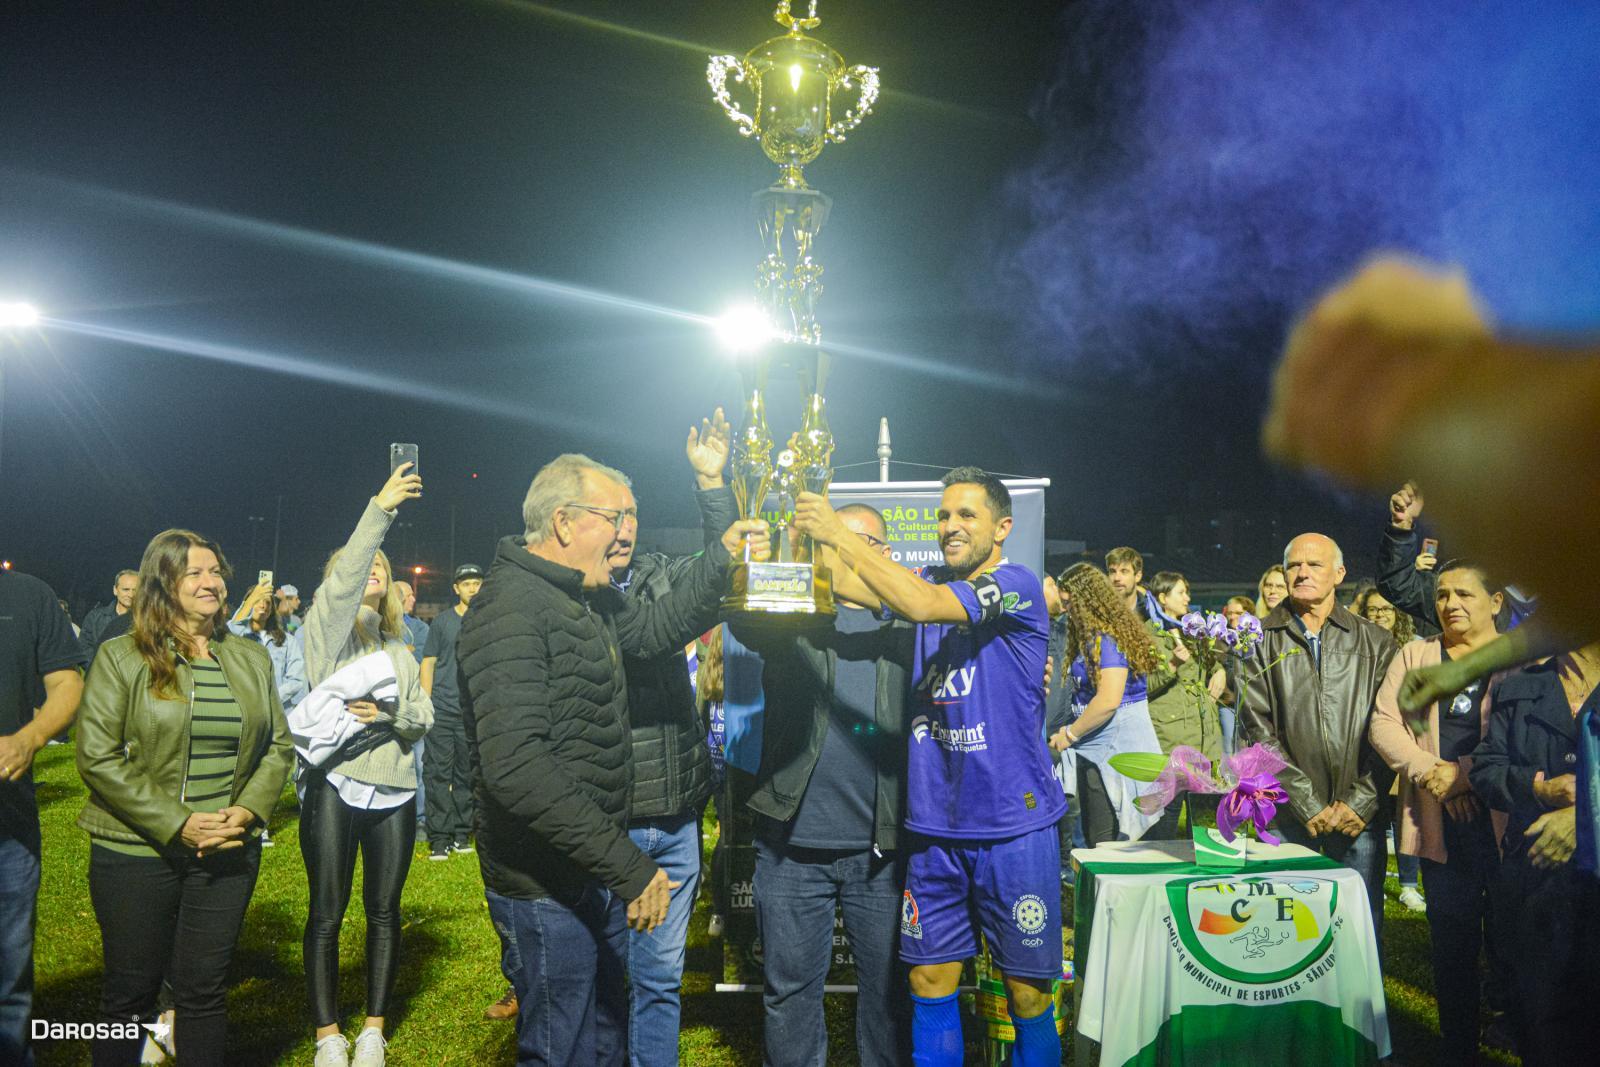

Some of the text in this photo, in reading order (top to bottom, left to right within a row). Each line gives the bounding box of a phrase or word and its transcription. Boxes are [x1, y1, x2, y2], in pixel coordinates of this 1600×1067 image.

[882, 506, 918, 521] SÃO
[898, 522, 938, 531] Cultura
[904, 533, 917, 541] DE
[754, 578, 807, 592] CAMPEÃO
[977, 584, 1001, 606] C
[1247, 882, 1277, 896] M
[1230, 897, 1294, 923] C E
[1183, 961, 1232, 998] MUNICIPAL
[1236, 988, 1249, 1001] DE
[1253, 980, 1301, 1001] ESPORTES
